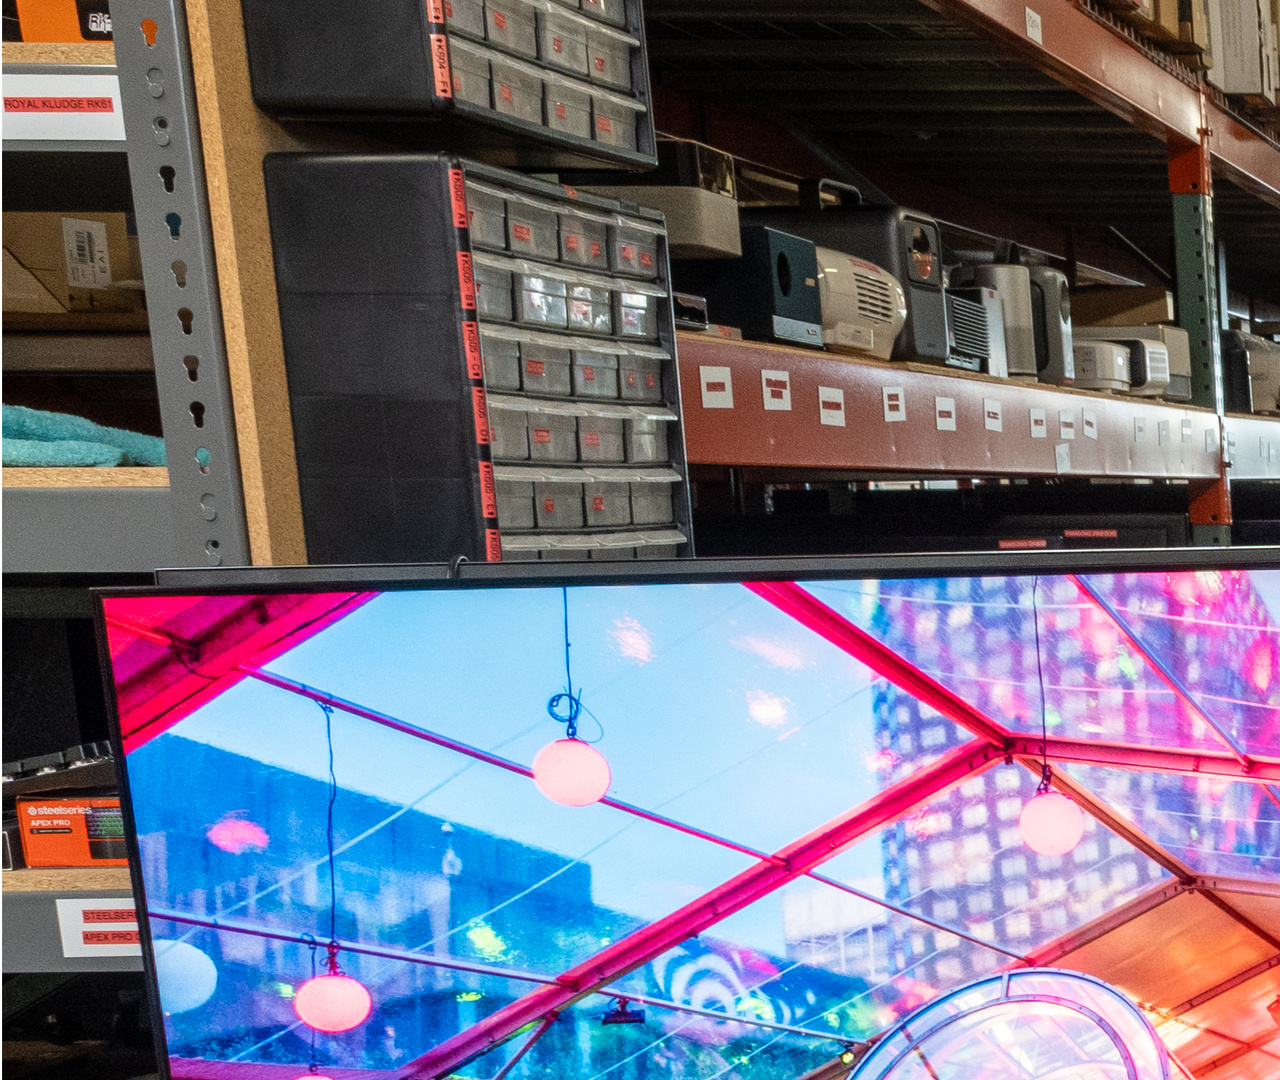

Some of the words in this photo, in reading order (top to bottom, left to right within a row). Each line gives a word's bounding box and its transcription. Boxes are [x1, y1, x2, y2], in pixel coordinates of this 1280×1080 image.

[5, 100, 39, 108] ROYAL
[42, 100, 84, 109] KLUDGE
[87, 100, 112, 108] RK61
[38, 806, 92, 815] steelseries
[84, 933, 109, 941] APEX
[113, 932, 133, 940] PRO
